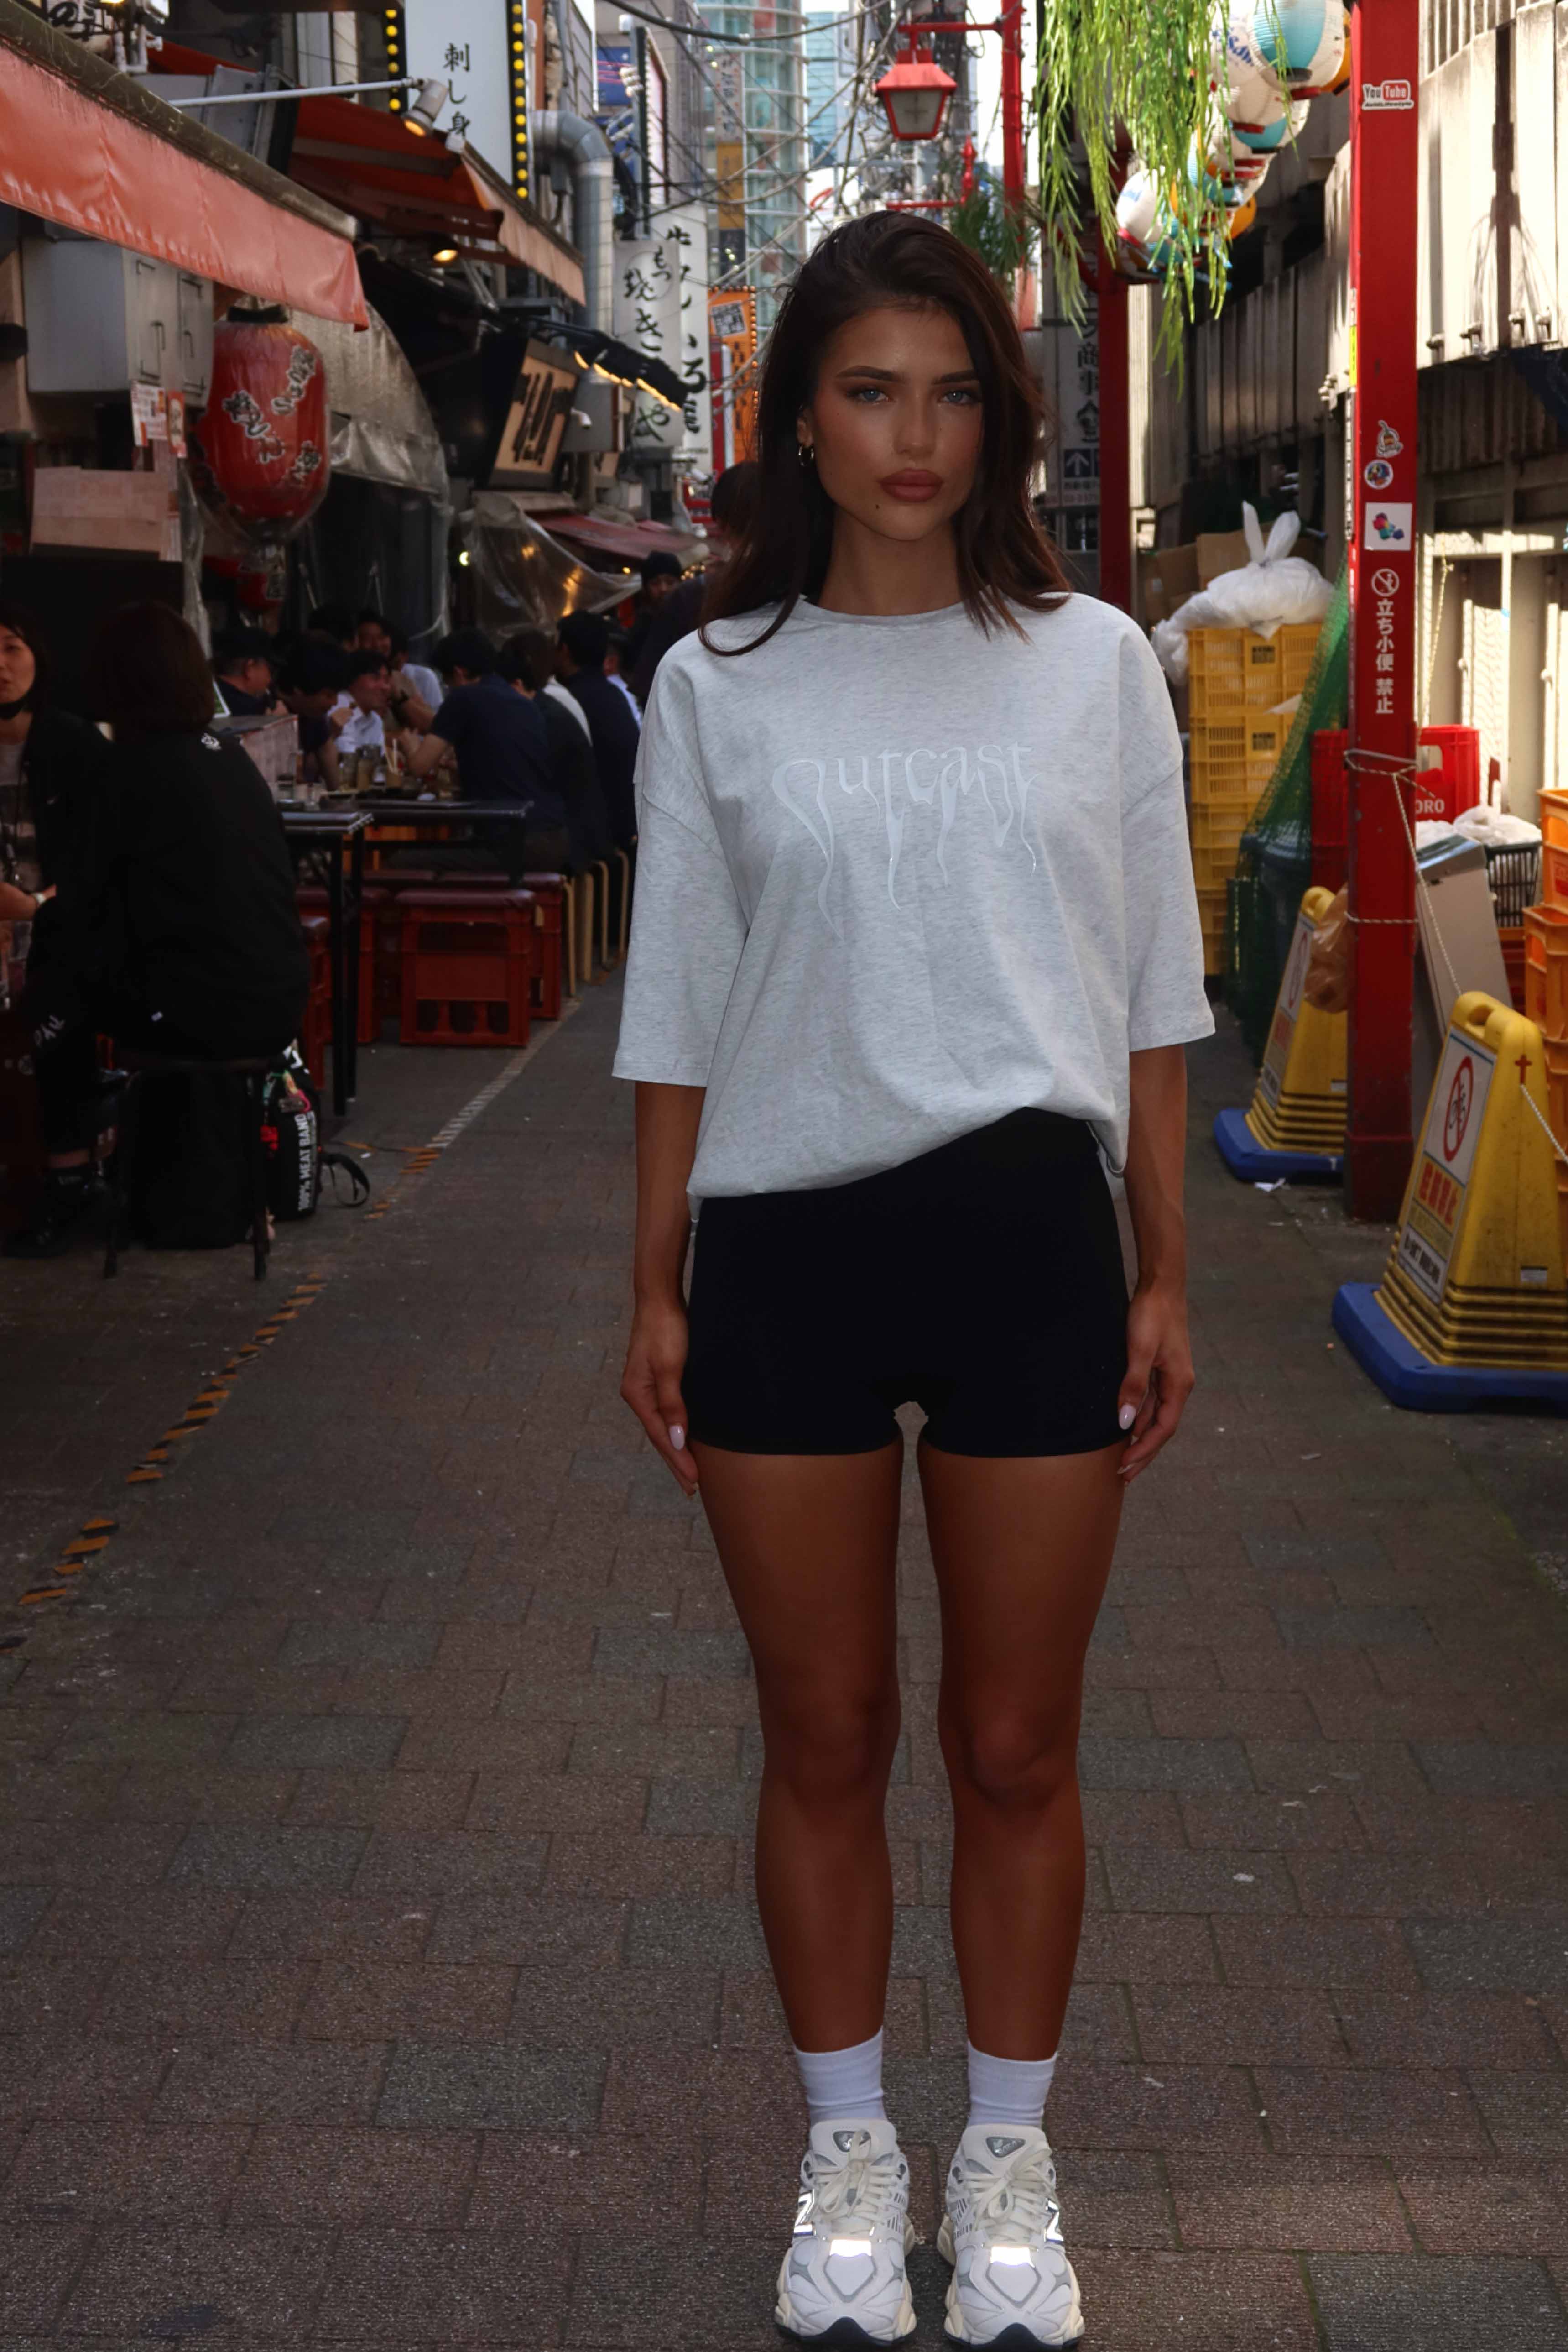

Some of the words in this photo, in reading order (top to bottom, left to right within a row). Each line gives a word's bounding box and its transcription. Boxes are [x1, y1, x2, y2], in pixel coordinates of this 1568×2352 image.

[443, 42, 470, 137] 刺し身
[1364, 85, 1407, 98] YouTube
[1376, 598, 1395, 671] 立ち小便
[1375, 678, 1394, 714] 禁止
[299, 1148, 311, 1181] MEAT
